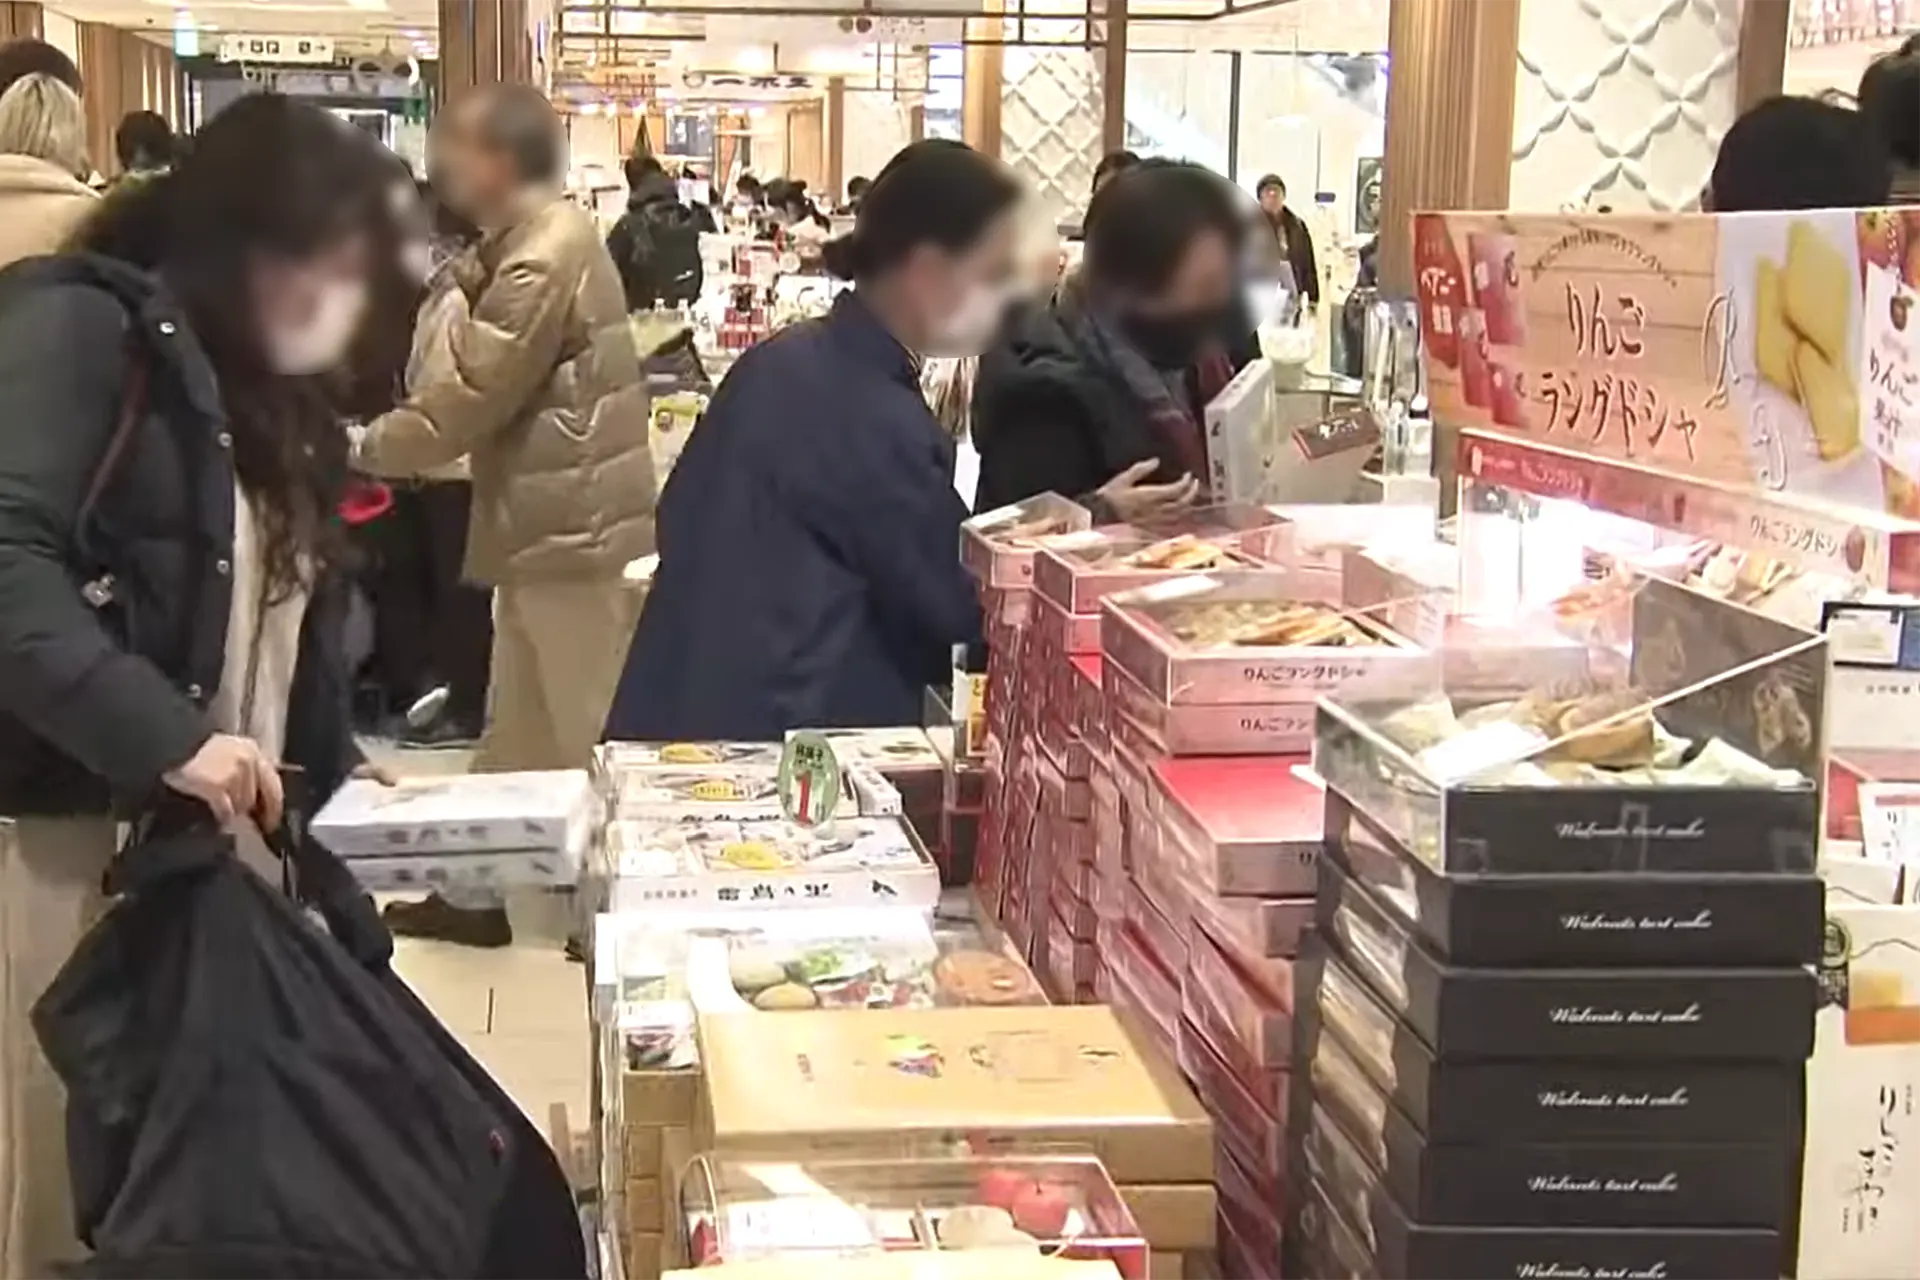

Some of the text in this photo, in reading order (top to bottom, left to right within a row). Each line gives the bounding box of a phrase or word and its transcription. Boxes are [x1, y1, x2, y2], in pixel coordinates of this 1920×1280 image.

[1565, 282, 1646, 358] りんご
[1541, 371, 1698, 463] ラングドシャ
